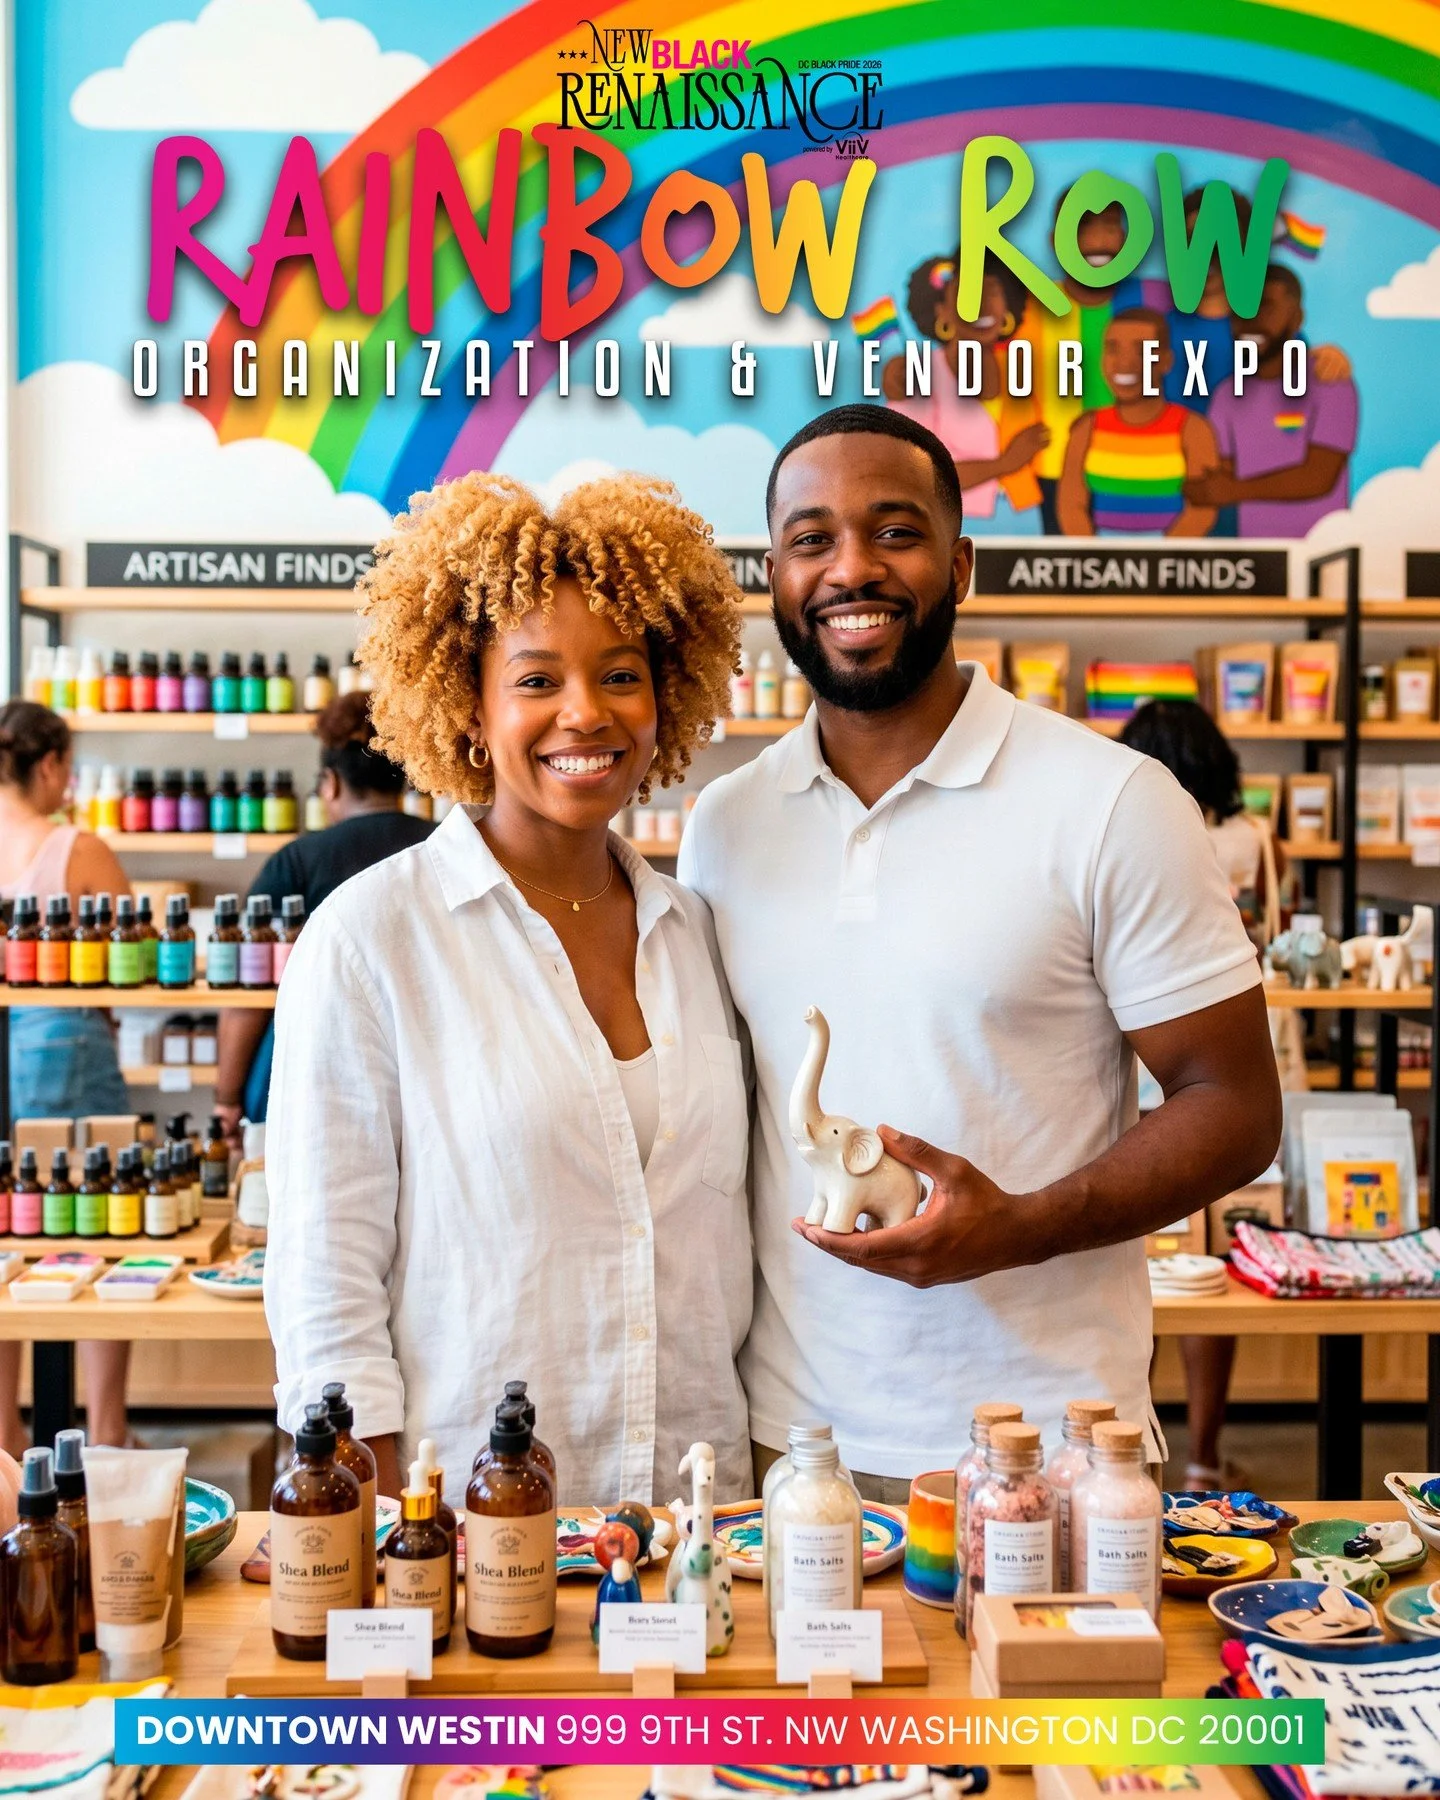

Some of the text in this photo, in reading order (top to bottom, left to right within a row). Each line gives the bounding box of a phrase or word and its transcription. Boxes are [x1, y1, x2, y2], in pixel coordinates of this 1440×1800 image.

[123, 551, 266, 583] ARTISAN
[1007, 557, 1256, 590] ARTISAN FINDS
[793, 1555, 844, 1566] Bath Salts
[994, 1552, 1045, 1564] Bath Salts
[1098, 1548, 1148, 1560] Bath Salts
[279, 1558, 350, 1577] Shea Blend
[475, 1560, 545, 1578] Shea Blend
[391, 1587, 442, 1601] Shea Blend
[354, 1622, 405, 1632] Shea Blend
[807, 1622, 852, 1631] Bath Salts
